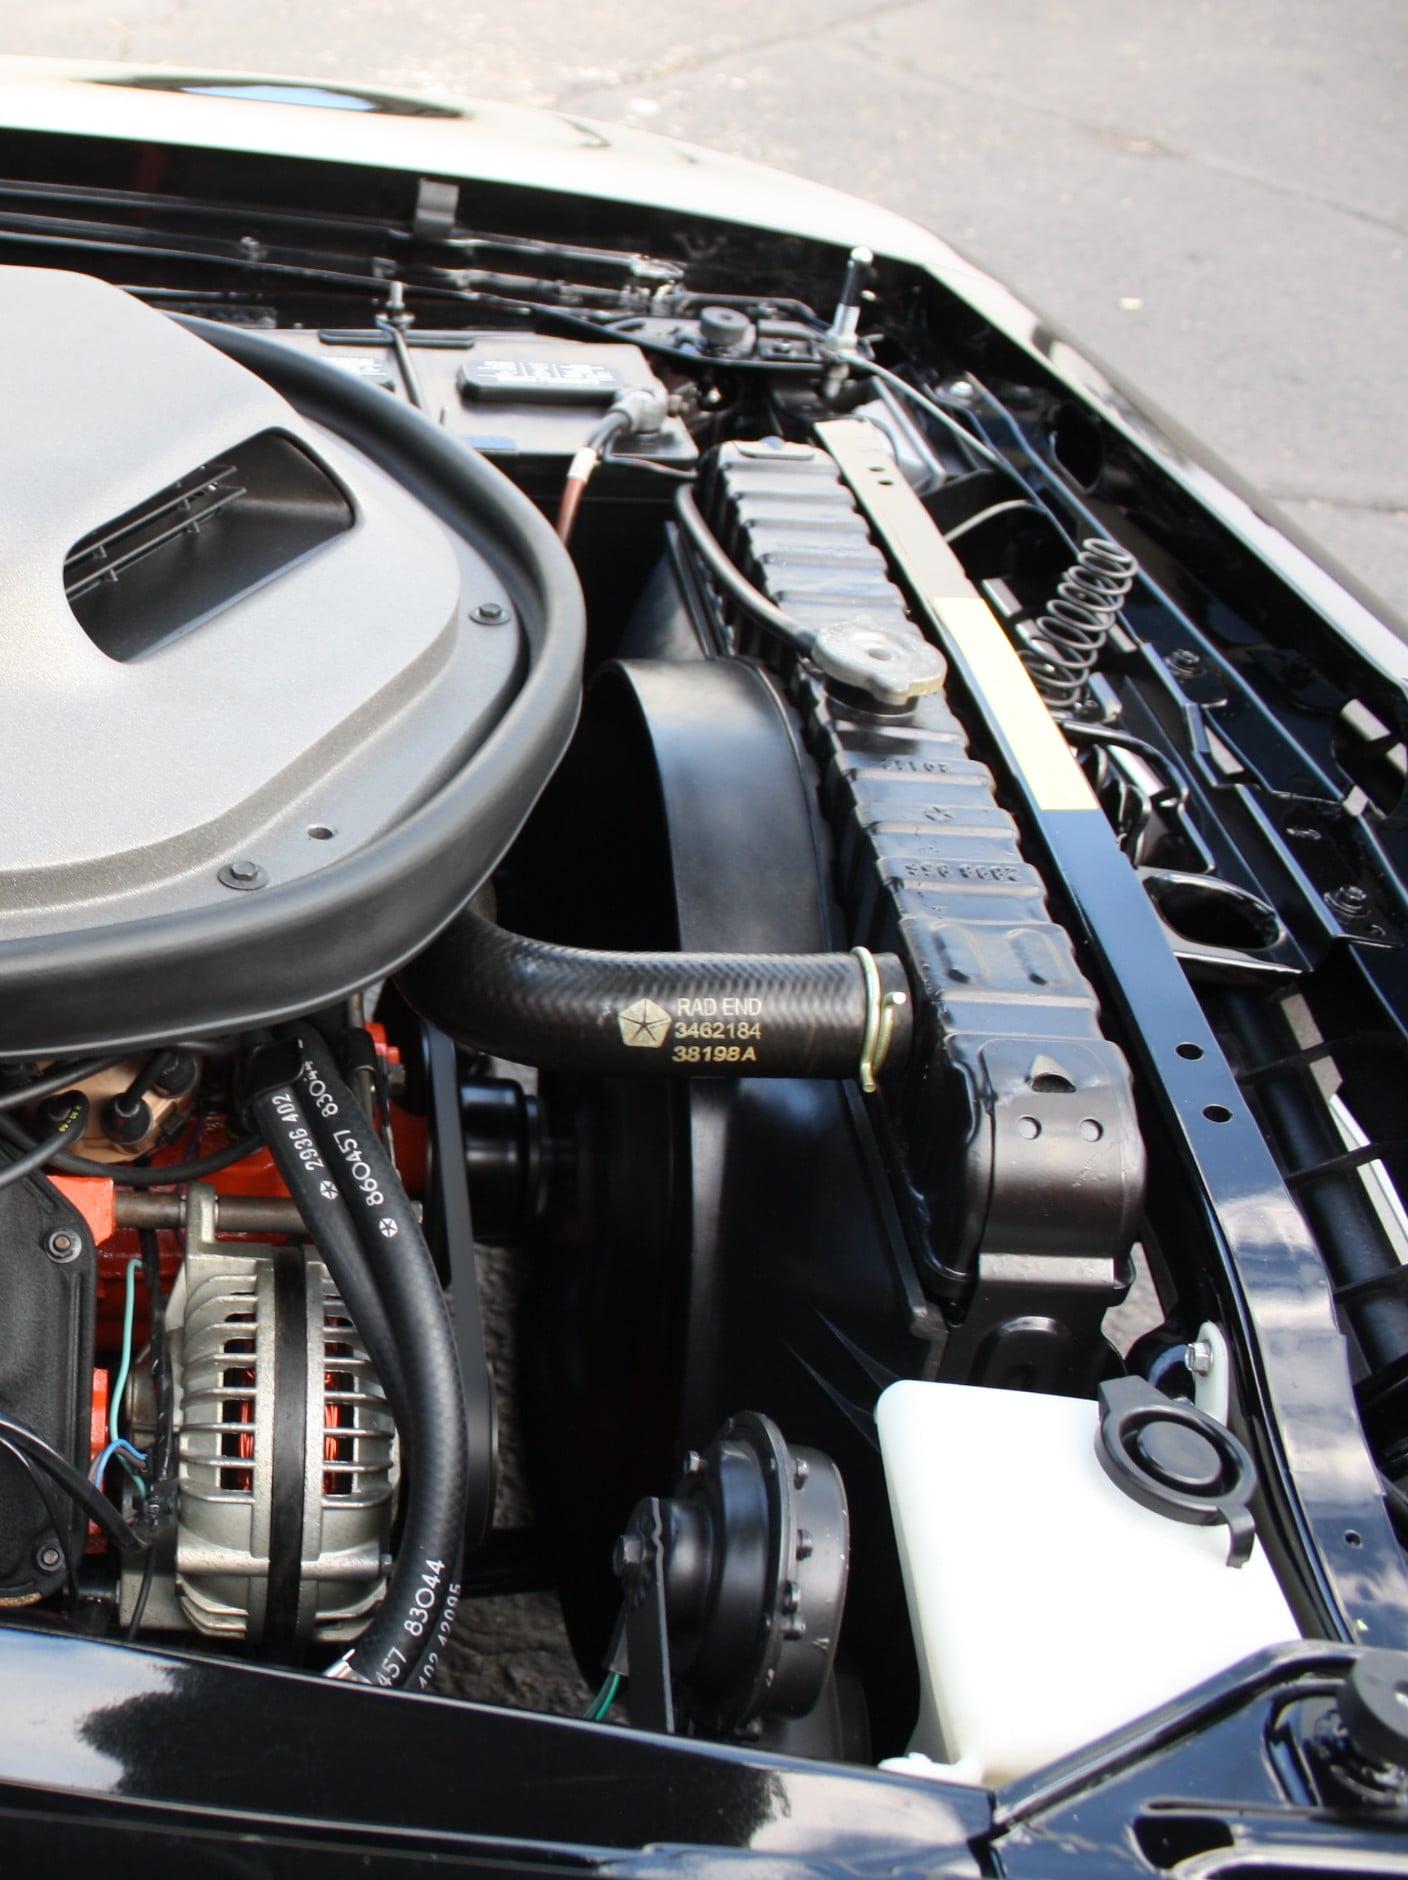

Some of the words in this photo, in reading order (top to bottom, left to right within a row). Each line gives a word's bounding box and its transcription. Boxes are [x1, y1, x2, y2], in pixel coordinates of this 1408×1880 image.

[677, 997, 717, 1017] RAD
[723, 997, 762, 1016] END
[674, 1021, 762, 1039] 3462184
[672, 1045, 757, 1062] 38198A
[271, 1093, 299, 1123] 402
[288, 1127, 325, 1171] 2936
[332, 1129, 384, 1207] 860457
[403, 1559, 445, 1637] 83044
